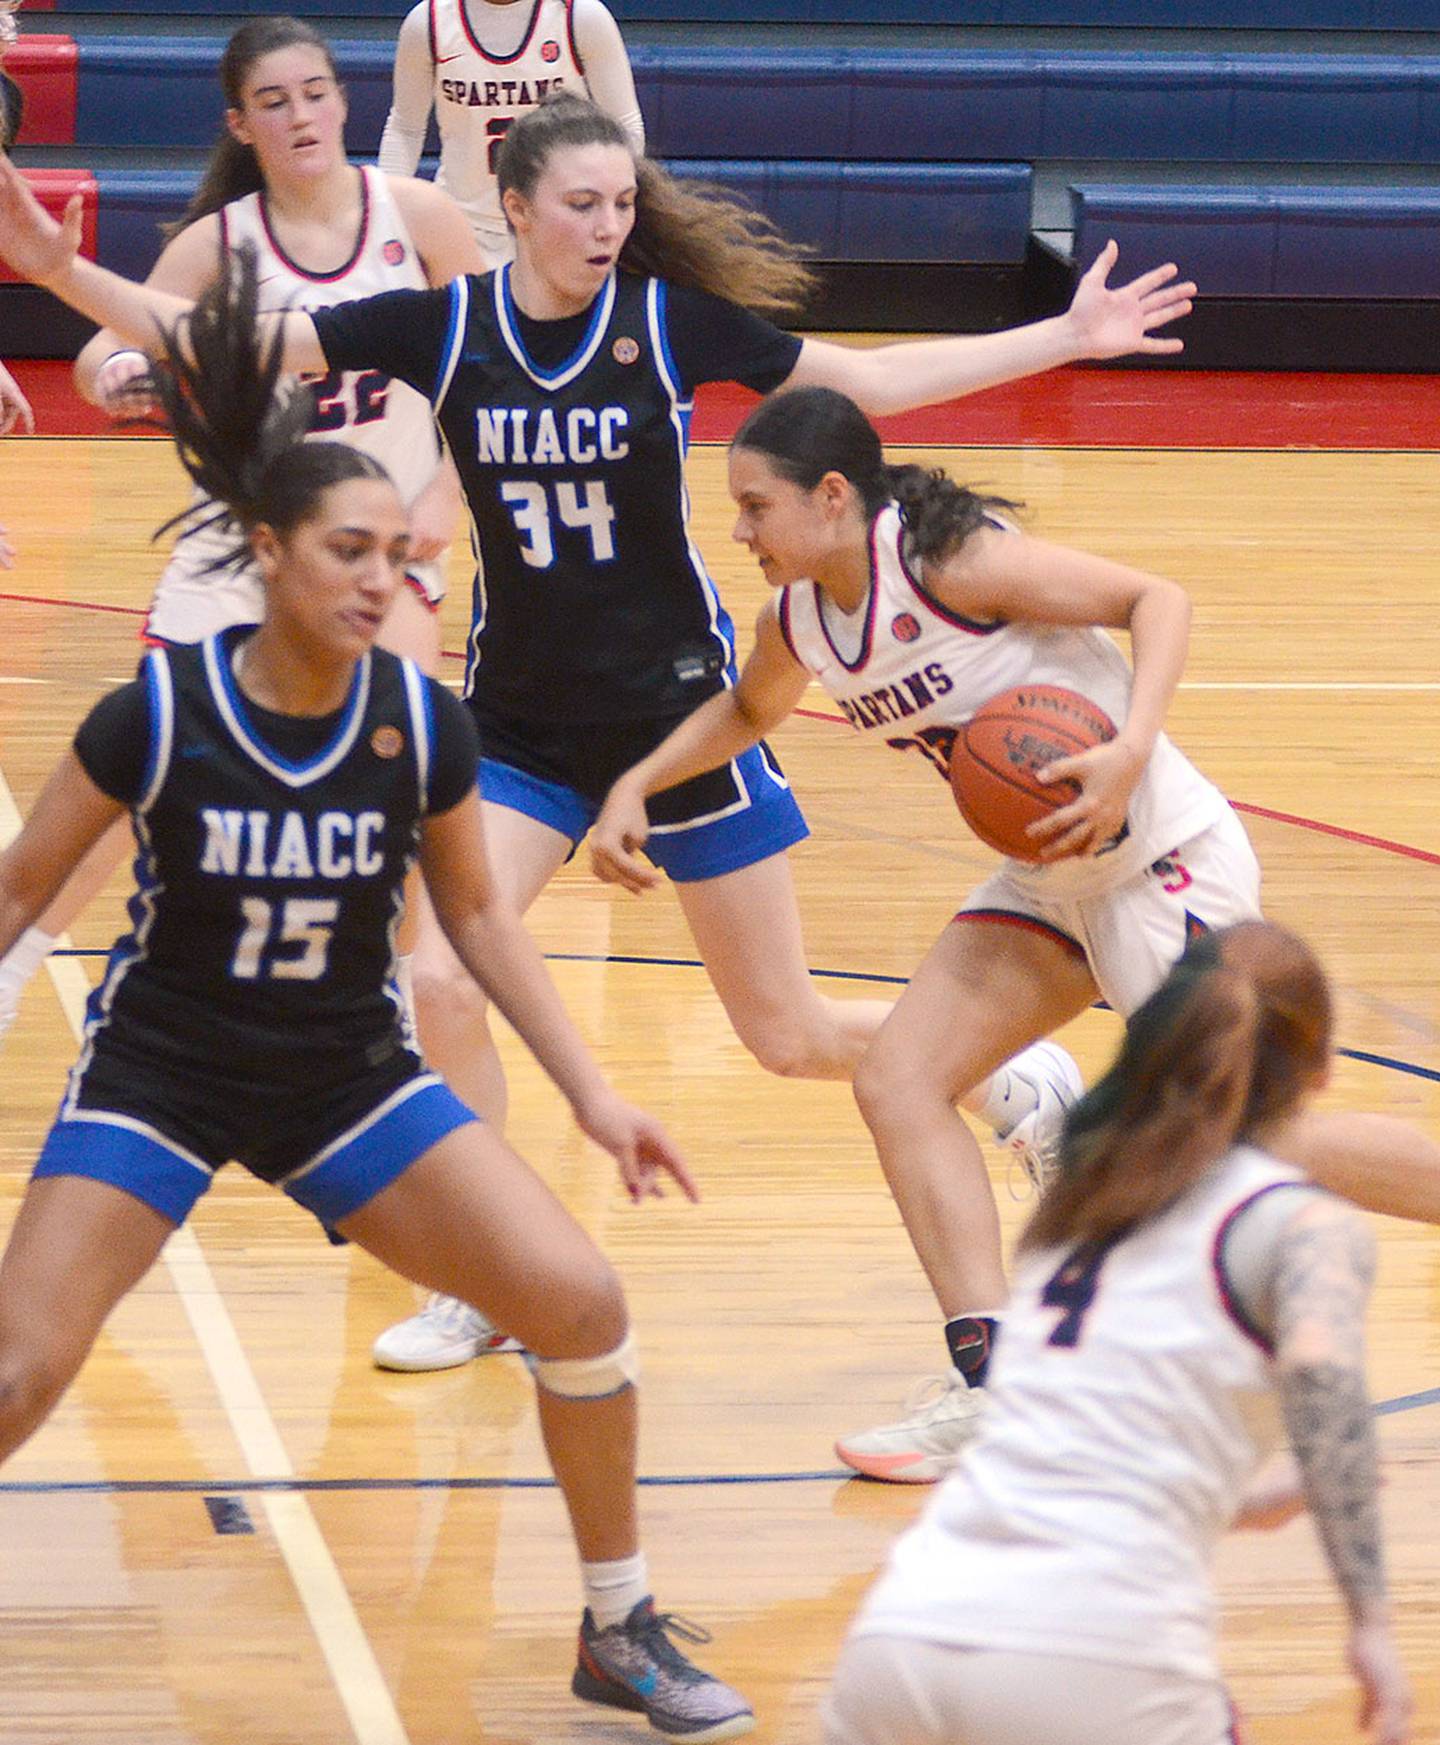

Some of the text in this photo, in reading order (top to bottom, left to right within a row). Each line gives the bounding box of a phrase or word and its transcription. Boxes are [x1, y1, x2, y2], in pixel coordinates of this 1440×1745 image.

[474, 405, 631, 465] NIACC
[500, 478, 617, 570] 34
[836, 662, 954, 731] PARTANS
[200, 807, 387, 879] NIACC
[232, 896, 340, 981] 15
